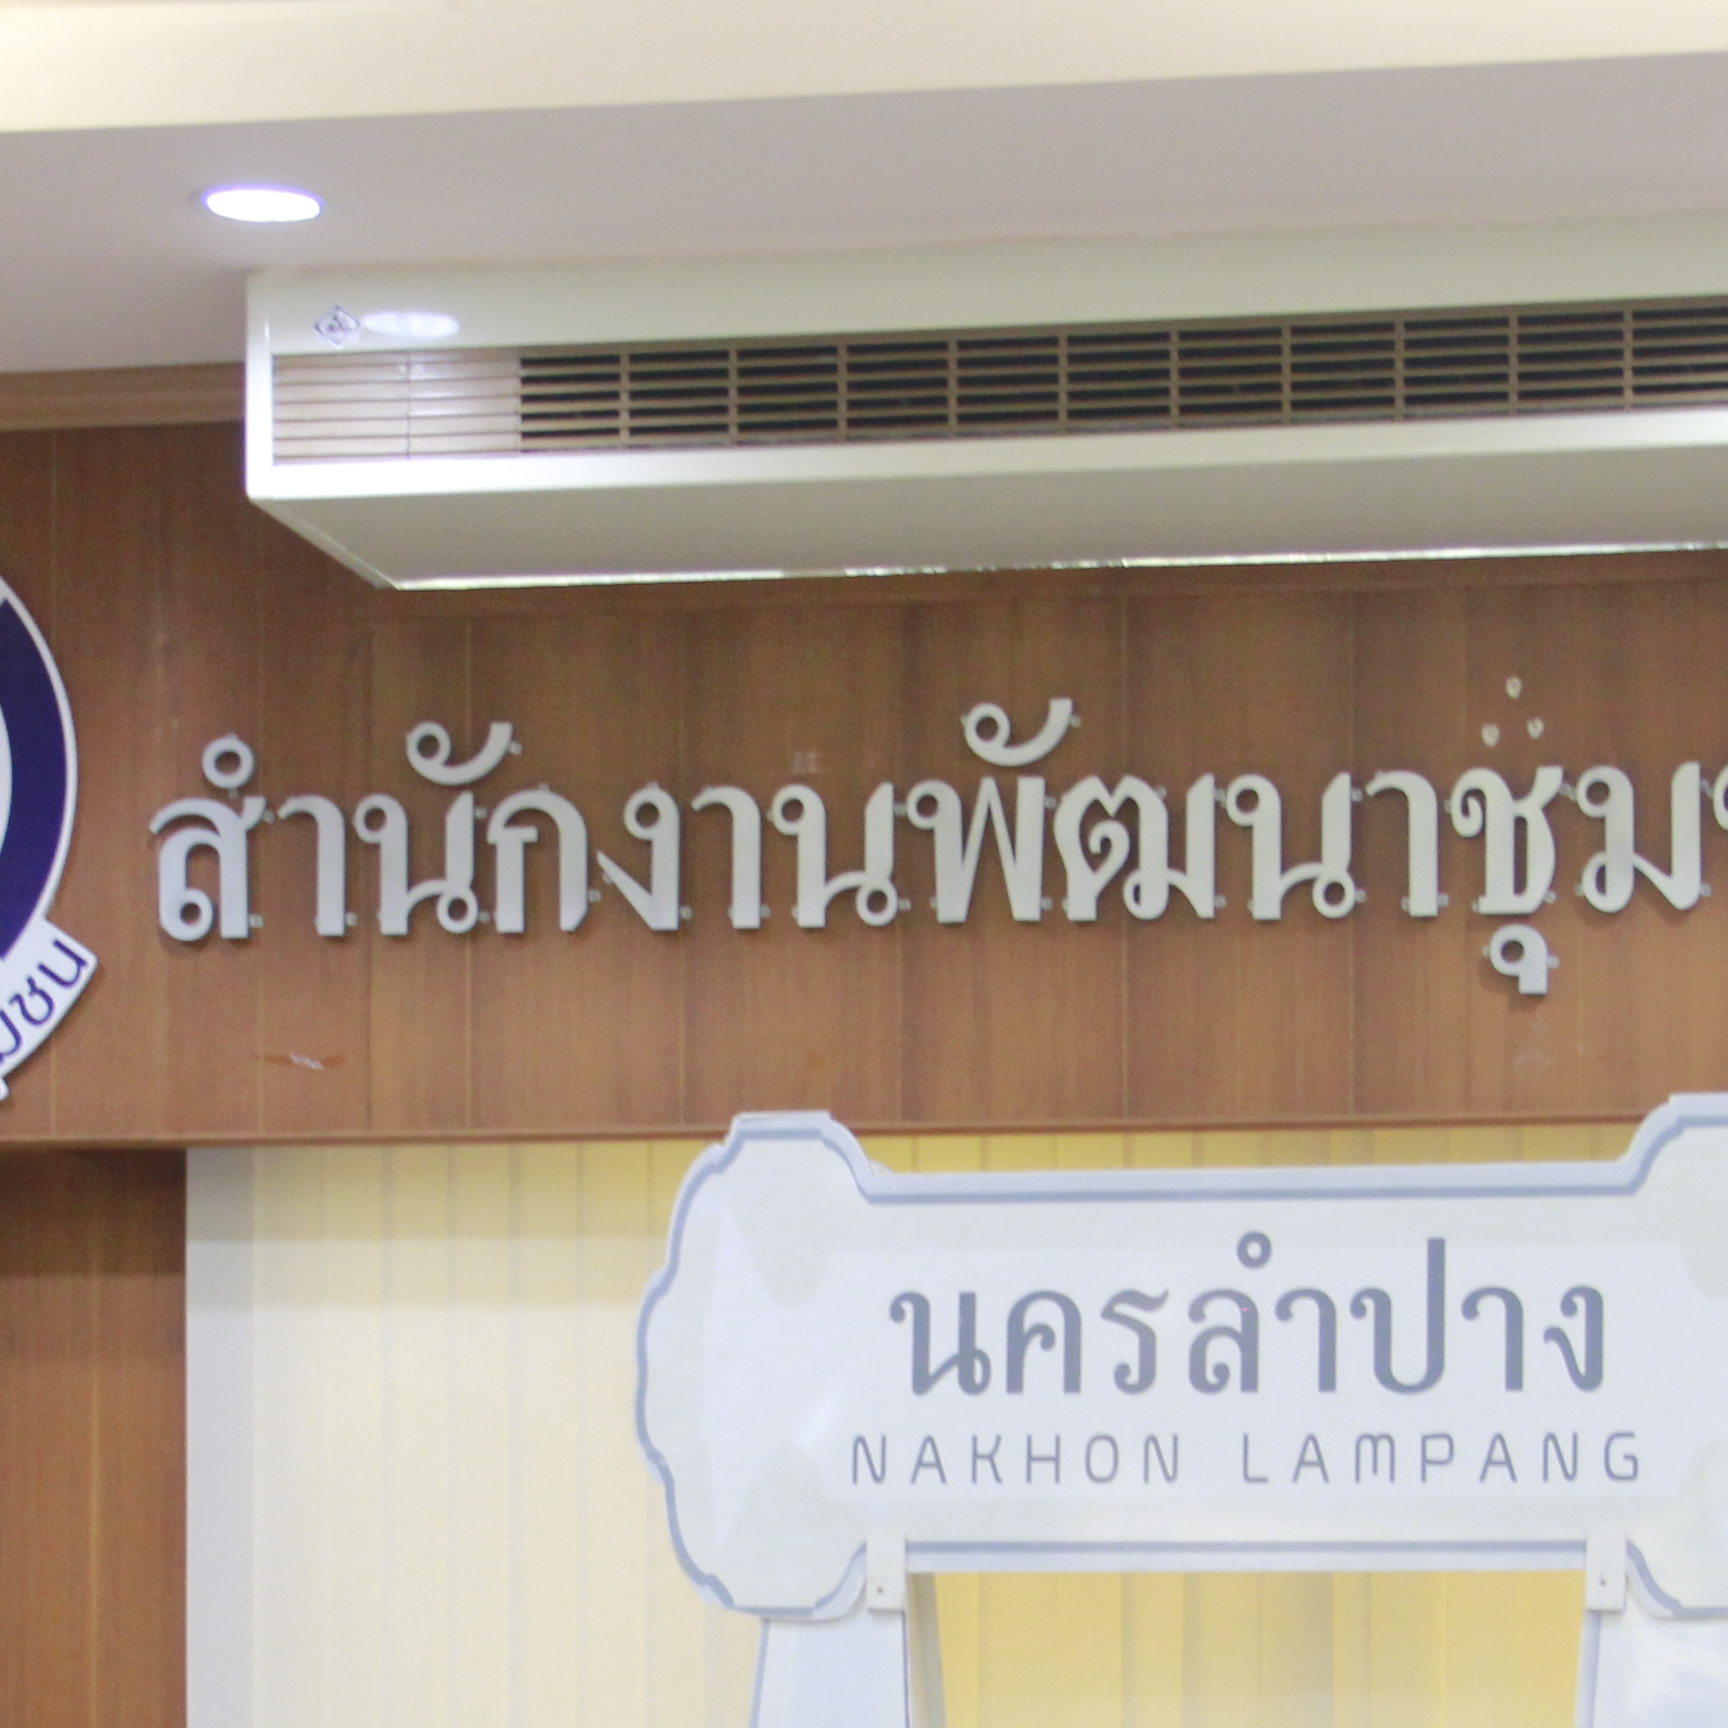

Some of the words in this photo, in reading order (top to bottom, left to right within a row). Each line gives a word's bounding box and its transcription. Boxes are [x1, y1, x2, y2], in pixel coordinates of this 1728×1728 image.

[888, 1231, 1605, 1395] นครลำปาง
[850, 1434, 1180, 1485] NAKHON
[1241, 1432, 1641, 1484] LAMPANG
